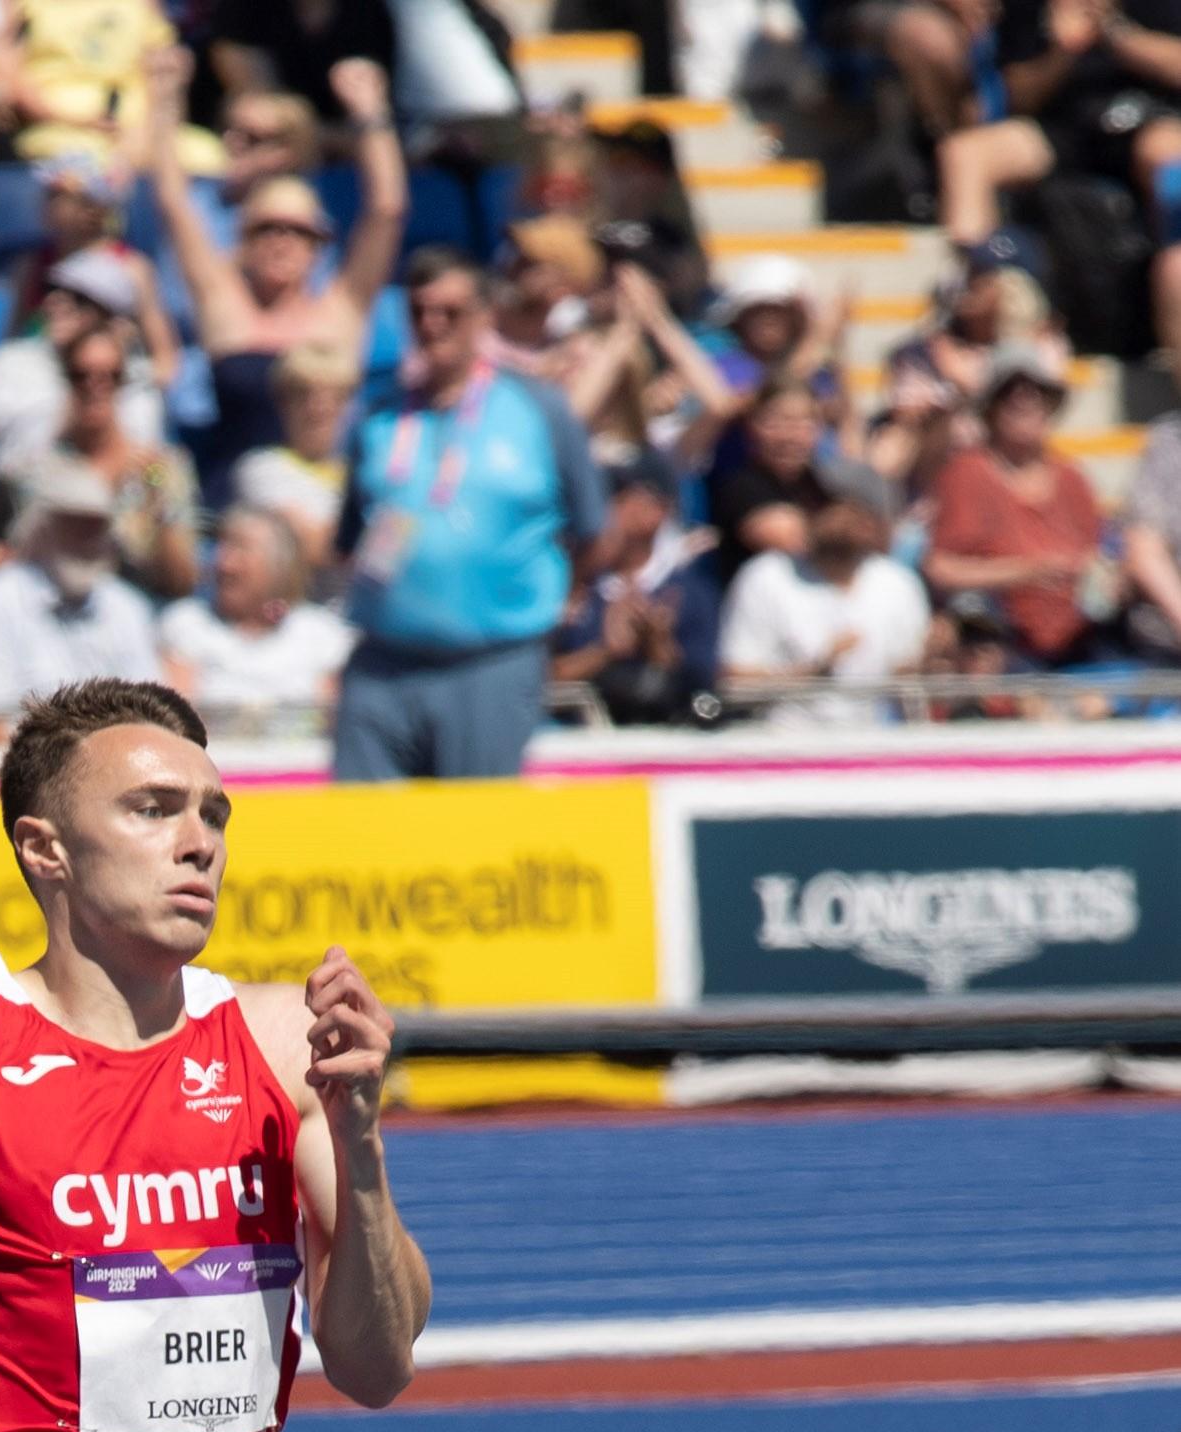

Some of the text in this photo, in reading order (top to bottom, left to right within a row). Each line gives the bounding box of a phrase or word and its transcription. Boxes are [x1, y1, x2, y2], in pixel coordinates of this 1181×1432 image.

[754, 866, 1140, 950] LONGINES
[51, 1164, 265, 1247] cymru
[108, 1279, 136, 1293] 2022
[165, 1329, 247, 1365] BRIER
[147, 1394, 258, 1419] LONGINES
